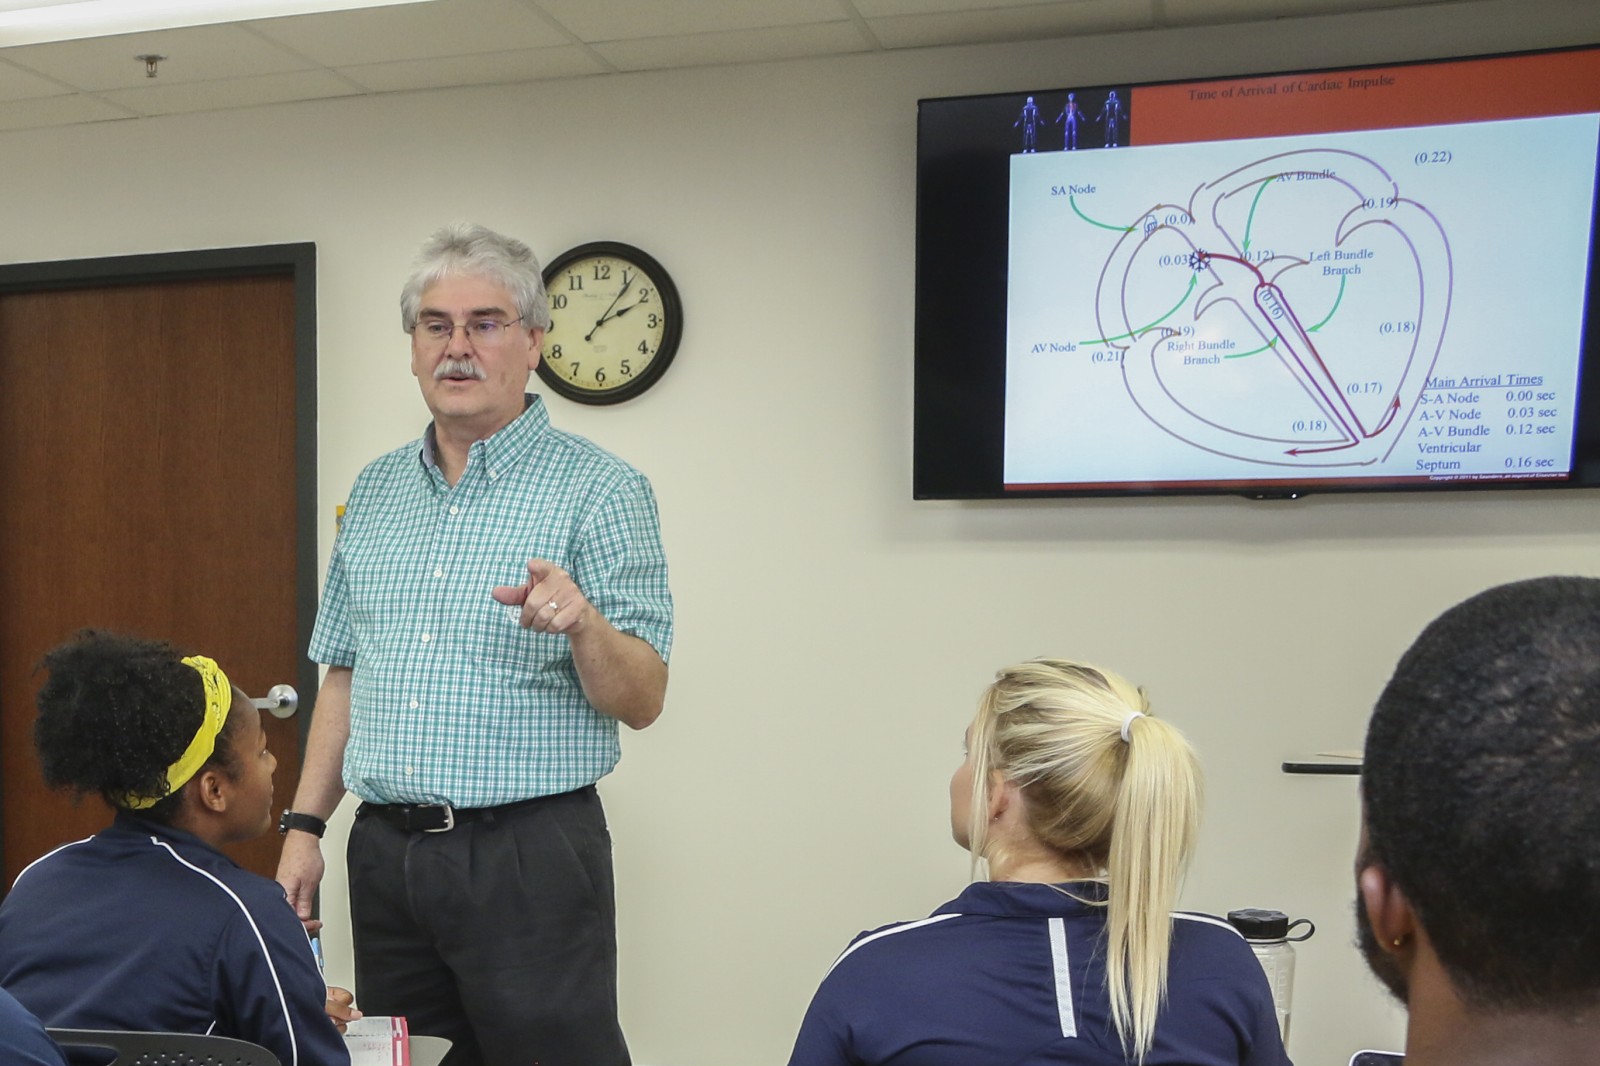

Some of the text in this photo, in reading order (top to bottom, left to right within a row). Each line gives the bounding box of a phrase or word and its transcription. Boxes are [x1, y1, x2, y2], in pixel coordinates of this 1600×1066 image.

[1188, 75, 1397, 101] Time of Arrival of Cardiac Impulse
[1414, 151, 1452, 165] (0.22)
[1276, 169, 1336, 182] AV Bundle
[1051, 184, 1097, 196] SA Node
[1362, 197, 1399, 210] (0.19)
[1164, 213, 1192, 225] (0.0)
[1158, 254, 1191, 267] (0.03
[1240, 250, 1275, 263] (0.12)
[1309, 249, 1374, 262] Left Bundle
[593, 265, 610, 280] 12
[621, 269, 629, 285] 1
[1322, 265, 1362, 277] Branch
[569, 276, 583, 290] 11
[552, 295, 567, 309] 10
[639, 288, 650, 304] 2
[1258, 288, 1284, 321] (0.16)
[647, 313, 658, 329] 3
[1379, 321, 1416, 335] (0.18)
[1160, 325, 1196, 338] (0.19)
[552, 344, 563, 359] 8
[637, 340, 649, 355] 4
[1031, 342, 1077, 354] AV Node
[1166, 339, 1236, 353] Right Bundle
[620, 359, 631, 375] 5
[1183, 354, 1221, 366] Branch
[570, 362, 581, 377] 7
[595, 368, 606, 383] 6
[1424, 374, 1544, 388] Main Arrival Times
[1346, 382, 1383, 396] (0.17)
[1420, 390, 1556, 405] S-A Node 0.00 sec
[1419, 407, 1558, 421] A-V Node 0.03 sec
[1291, 420, 1328, 434] (0.18)
[1418, 424, 1556, 437] A-V Bundle 0.12 sec
[1418, 442, 1482, 454] Ventricular
[1415, 457, 1555, 473] Septum 0.16 sec
